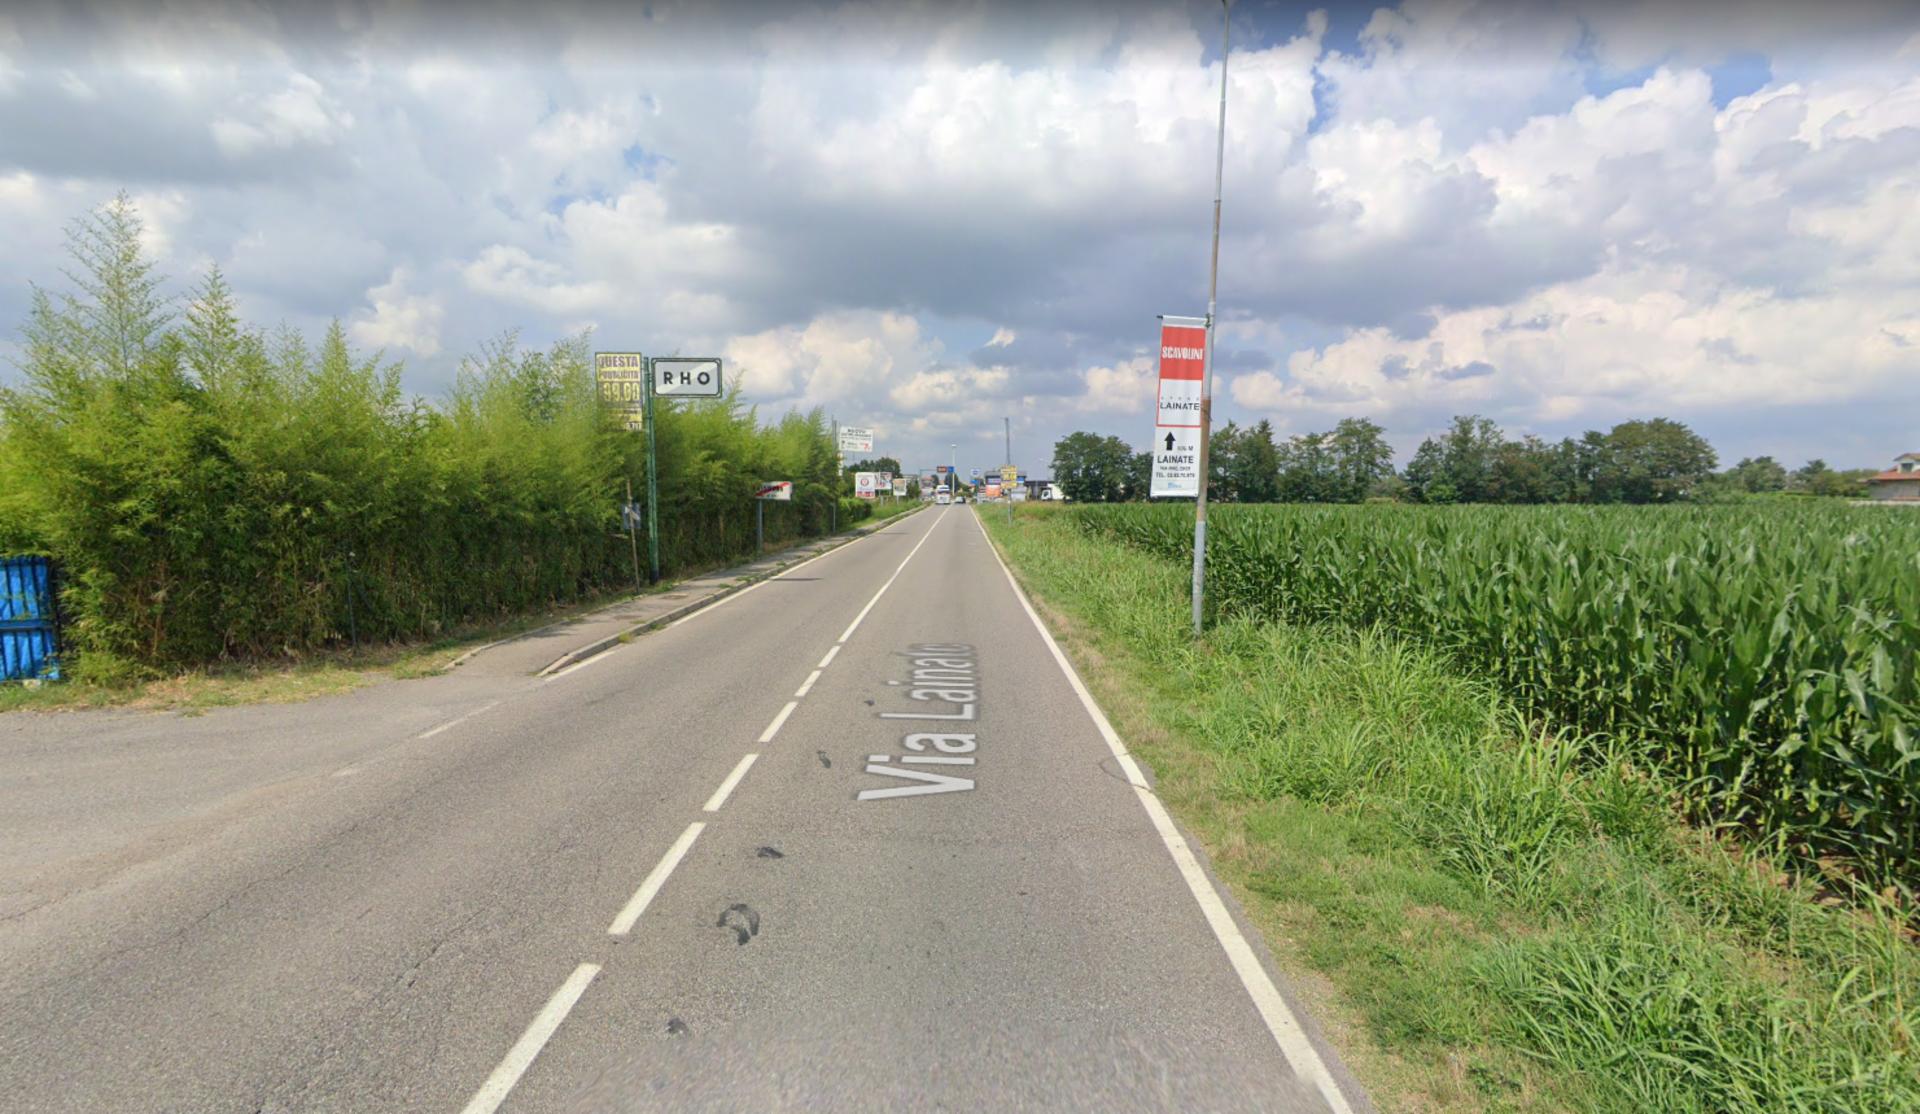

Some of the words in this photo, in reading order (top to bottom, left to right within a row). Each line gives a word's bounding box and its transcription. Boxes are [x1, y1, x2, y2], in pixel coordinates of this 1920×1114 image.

[1162, 346, 1204, 360] SCAVOLINI
[664, 371, 710, 385] RHO
[1160, 402, 1200, 411] LAINATE
[1157, 455, 1194, 464] LAINATE
